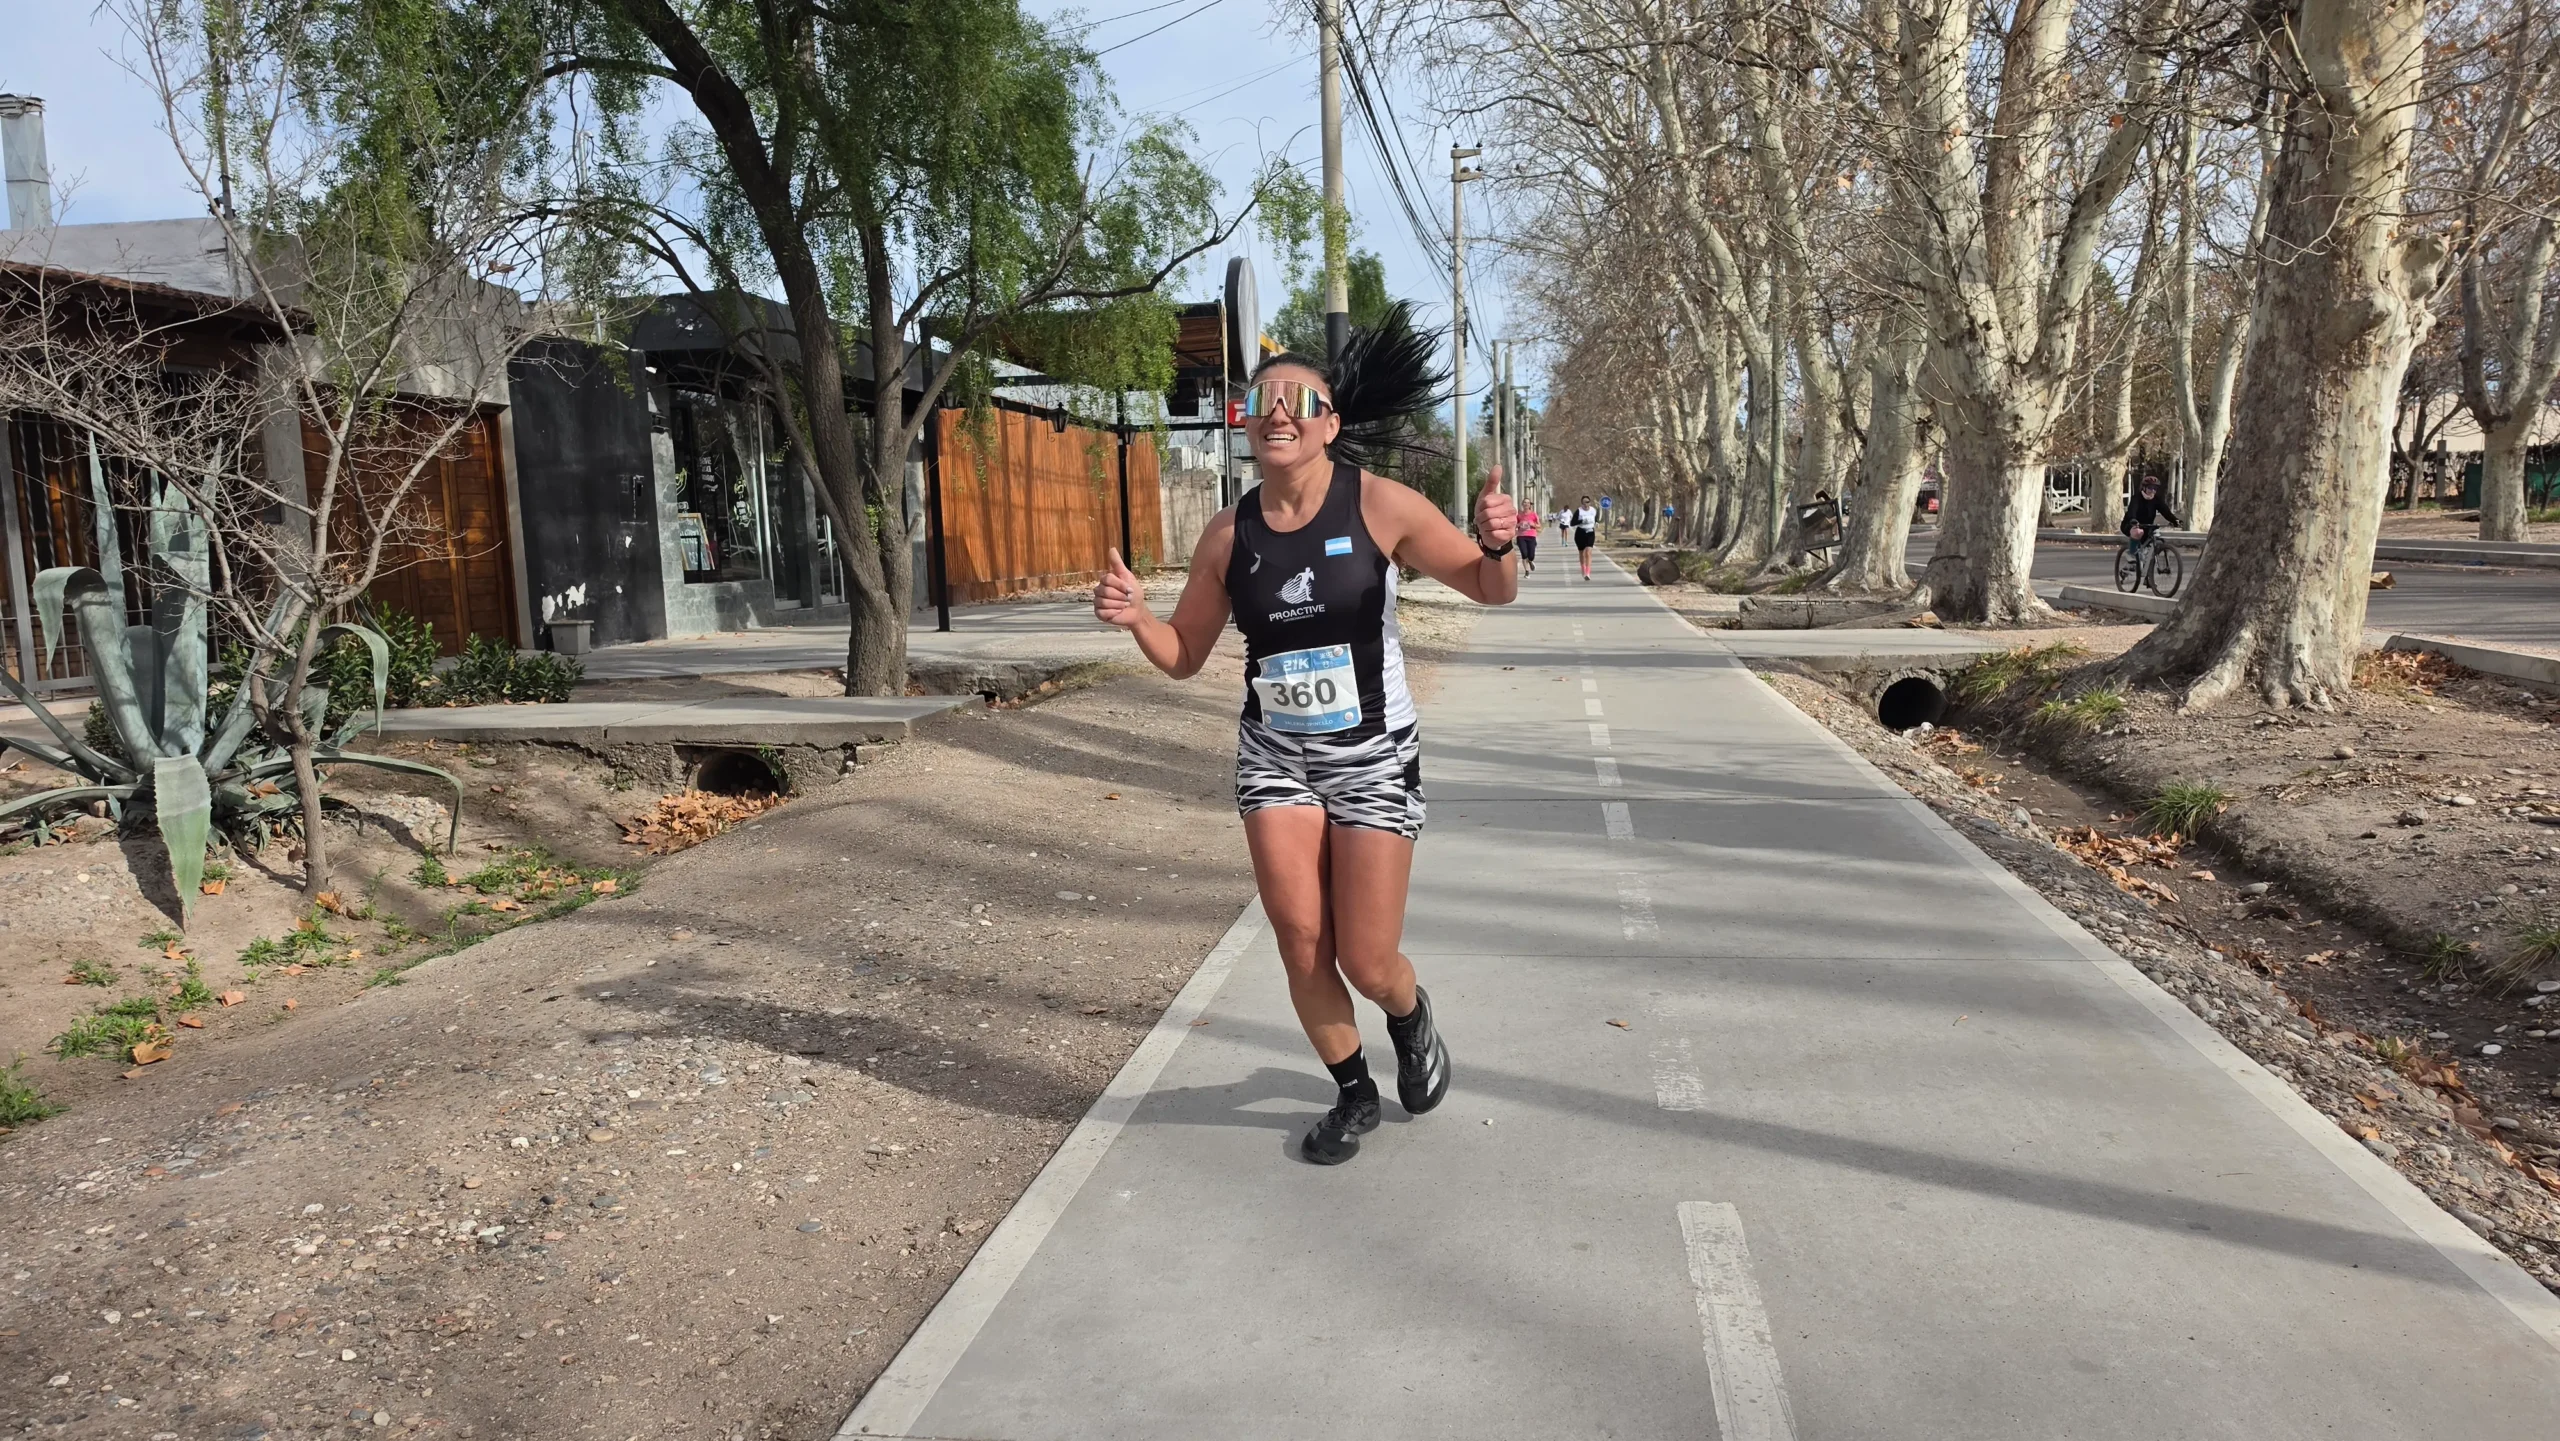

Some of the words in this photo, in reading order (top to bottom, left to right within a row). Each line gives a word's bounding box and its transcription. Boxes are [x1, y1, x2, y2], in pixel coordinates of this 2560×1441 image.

[1269, 604, 1326, 622] PROACTIVE
[1283, 657, 1310, 672] 21K
[1270, 677, 1337, 708] 360
